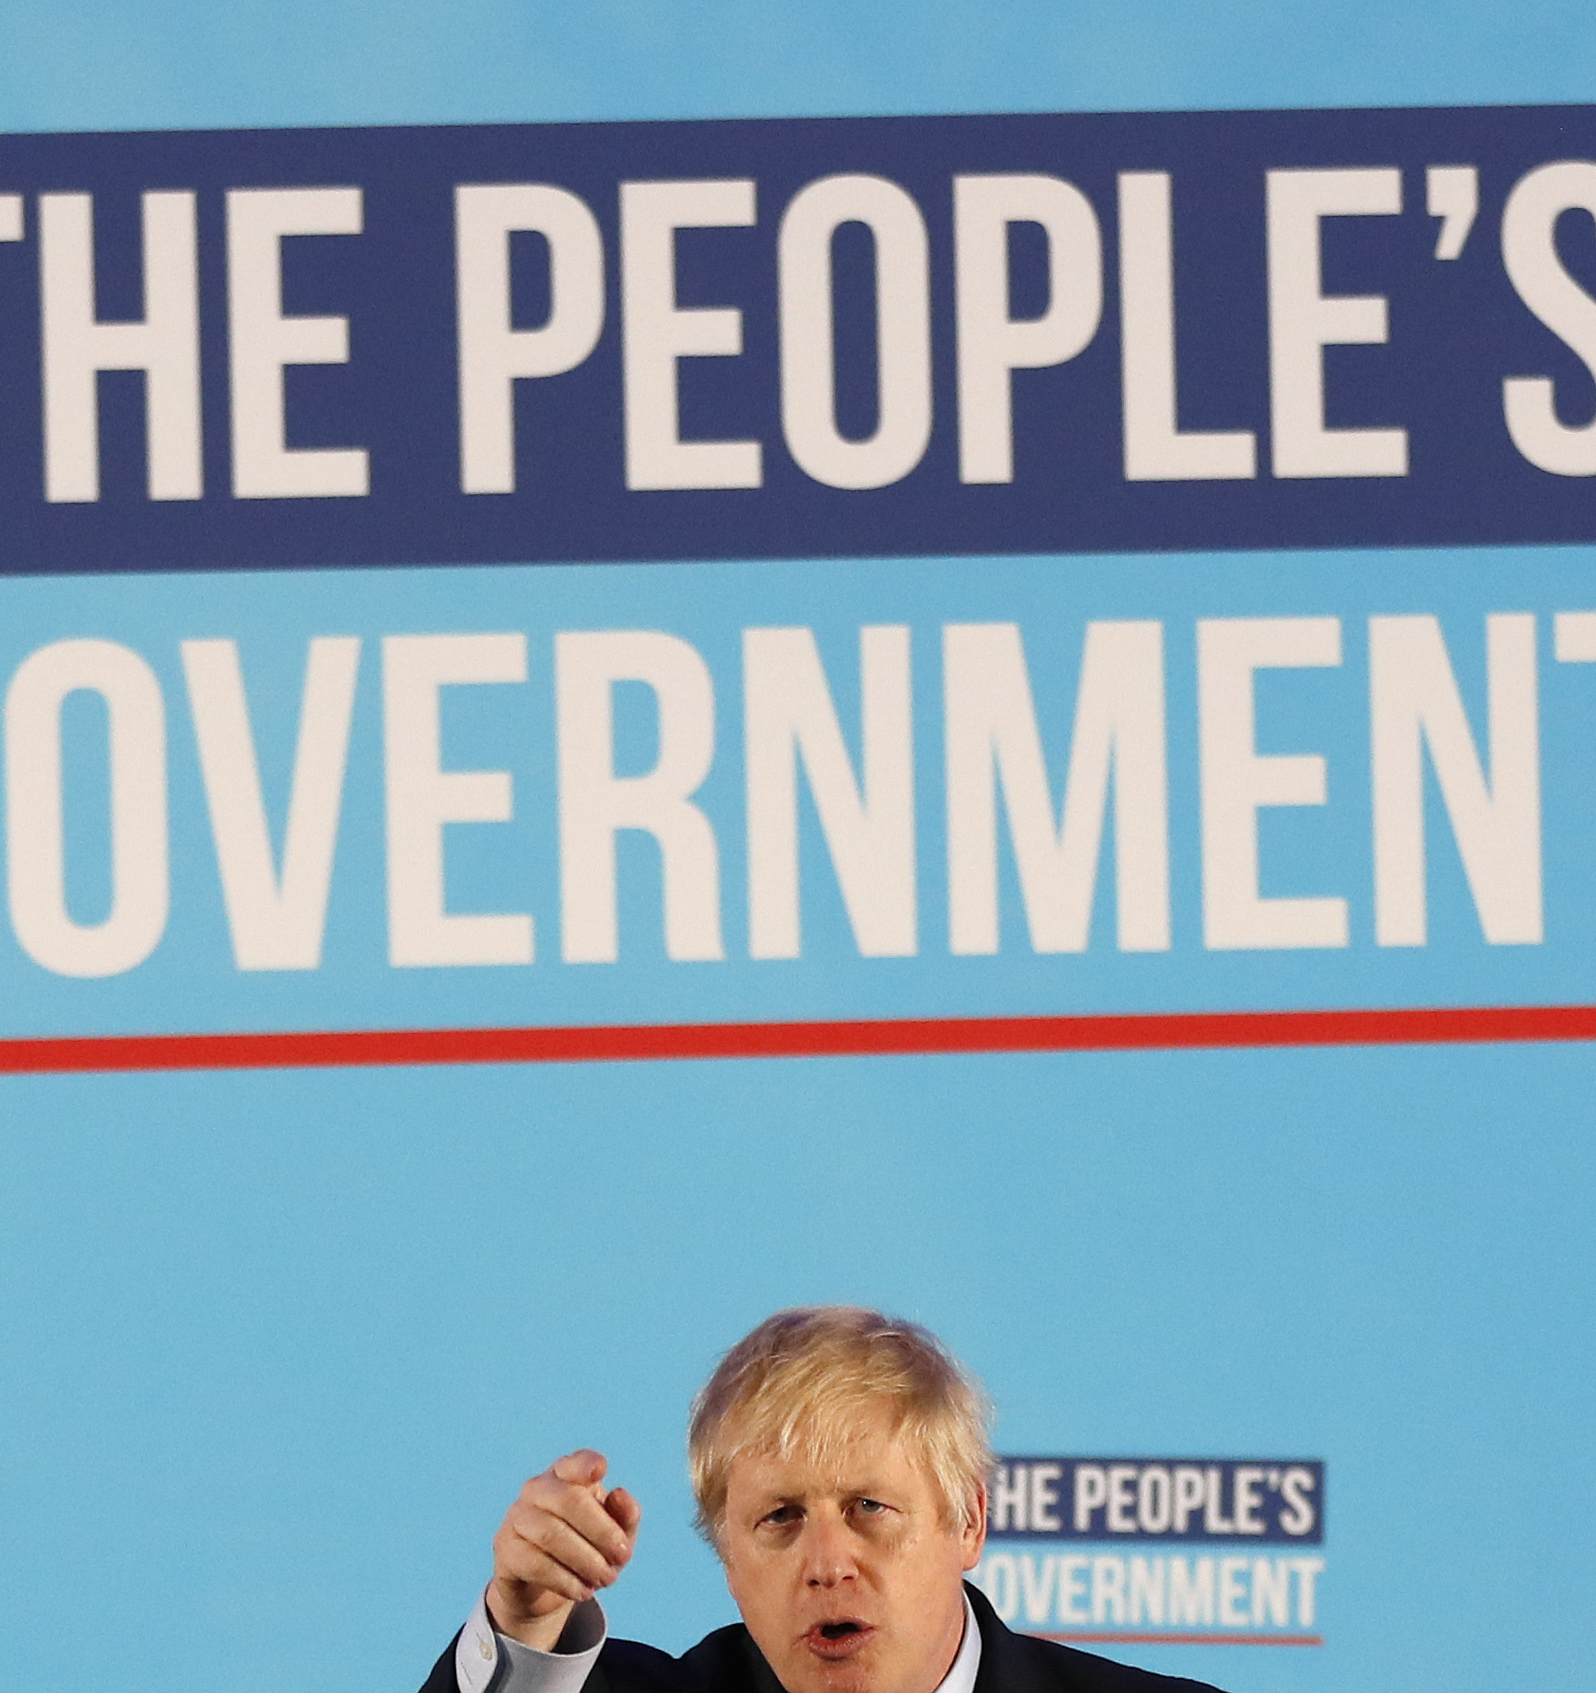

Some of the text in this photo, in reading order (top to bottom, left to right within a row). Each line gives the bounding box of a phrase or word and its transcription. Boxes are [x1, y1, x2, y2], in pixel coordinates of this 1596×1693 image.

[991, 1463, 1315, 1535] HE PEOPLE’S
[972, 1552, 1325, 1628] OVERNMENT
